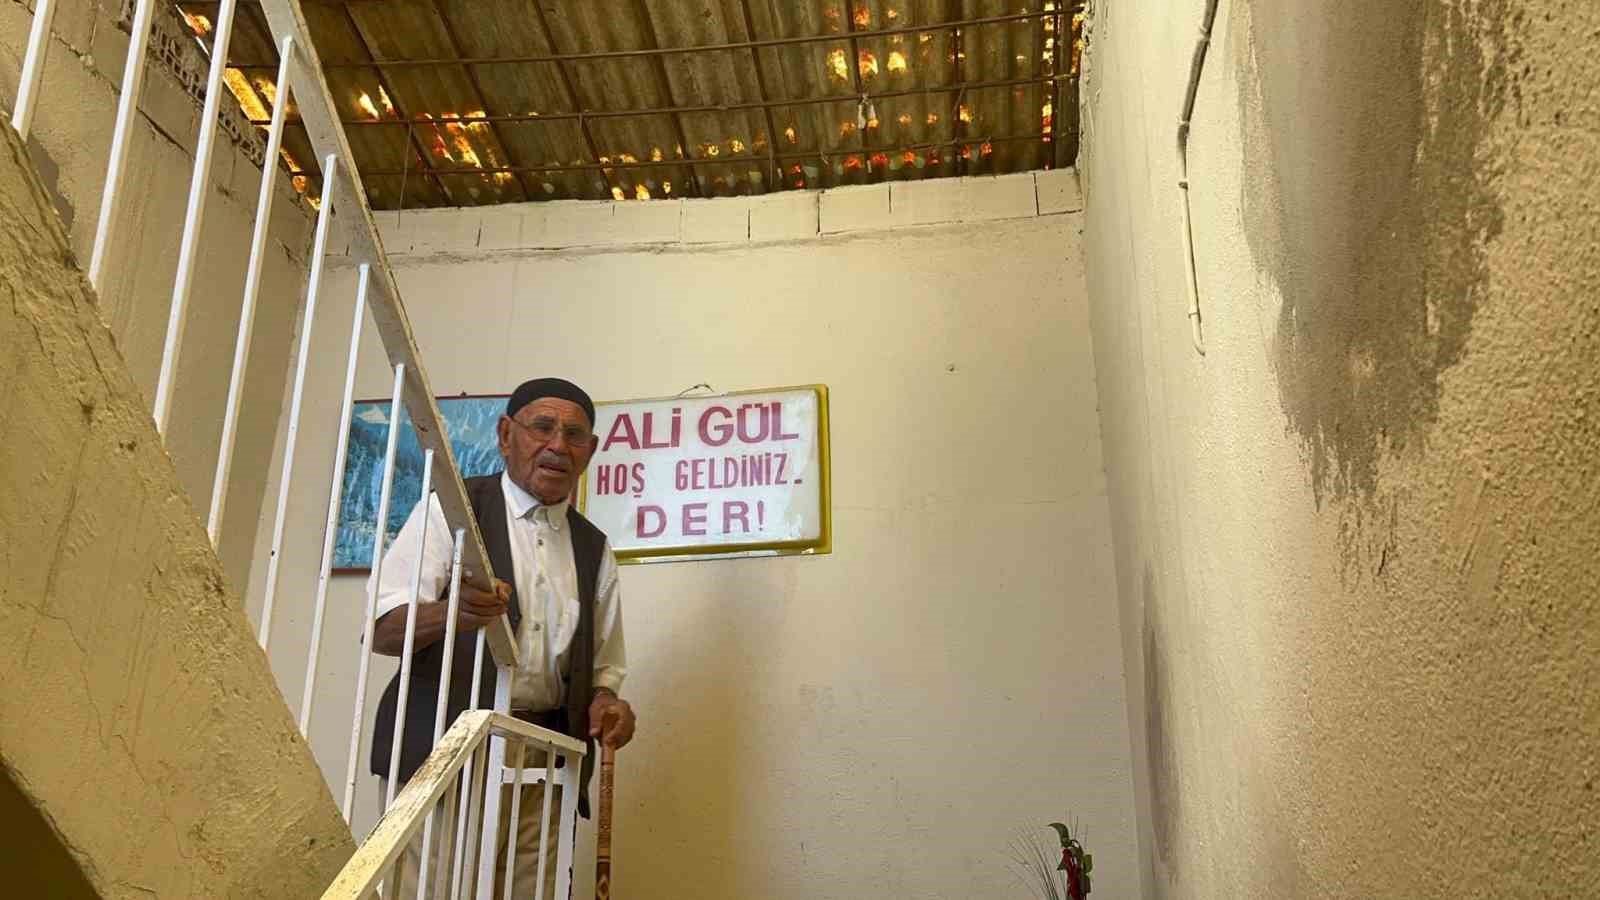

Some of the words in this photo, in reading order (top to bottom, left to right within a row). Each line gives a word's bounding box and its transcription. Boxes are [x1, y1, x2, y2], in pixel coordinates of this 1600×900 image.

[698, 402, 800, 448] GÜL
[596, 462, 646, 498] HOŞ
[636, 500, 765, 539] DER!
